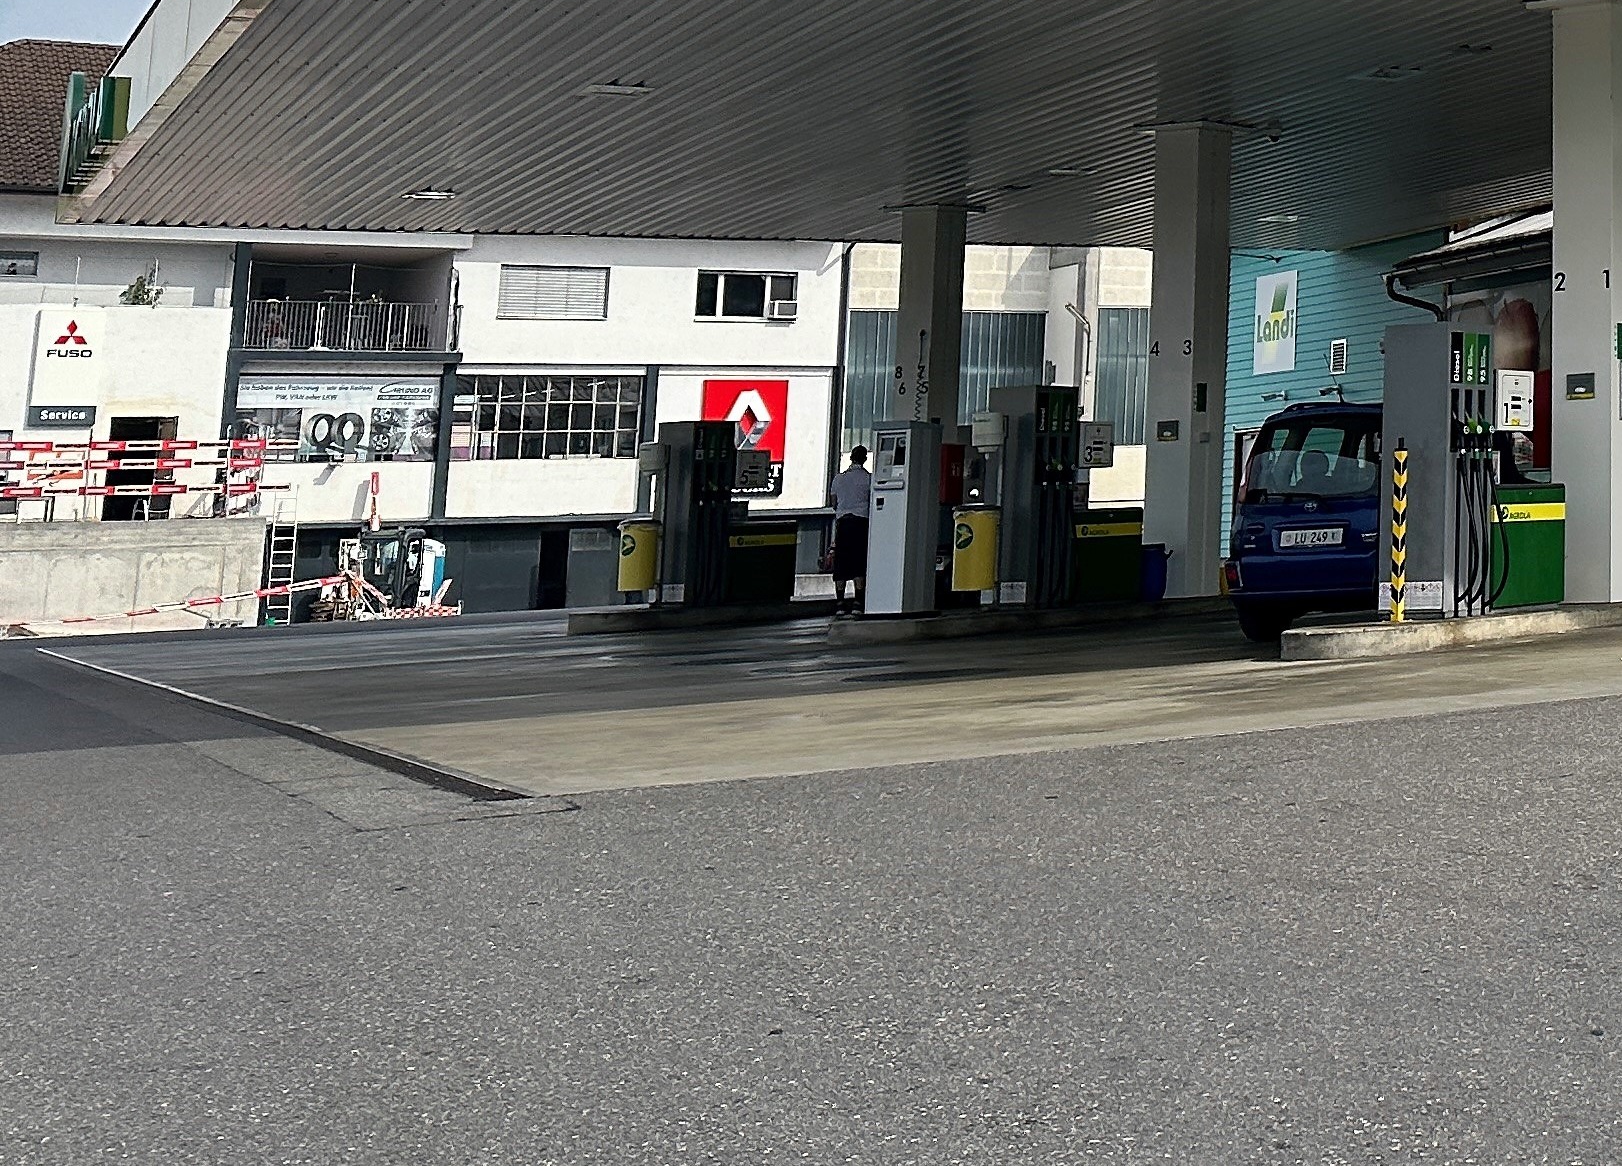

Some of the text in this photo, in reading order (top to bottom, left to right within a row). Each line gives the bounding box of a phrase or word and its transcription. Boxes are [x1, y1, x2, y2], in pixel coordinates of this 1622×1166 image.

[1554, 269, 1610, 291] 2 1
[1256, 309, 1295, 342] Landi
[46, 349, 93, 358] FUSO
[1150, 340, 1192, 356] 4 3
[894, 365, 903, 379] 8
[1453, 350, 1461, 382] Diesel
[898, 381, 906, 395] 6
[39, 409, 87, 421] Service
[1503, 402, 1509, 424] 1
[1083, 445, 1093, 463] 3
[740, 470, 749, 485] 5
[1295, 531, 1329, 545] LU 249
